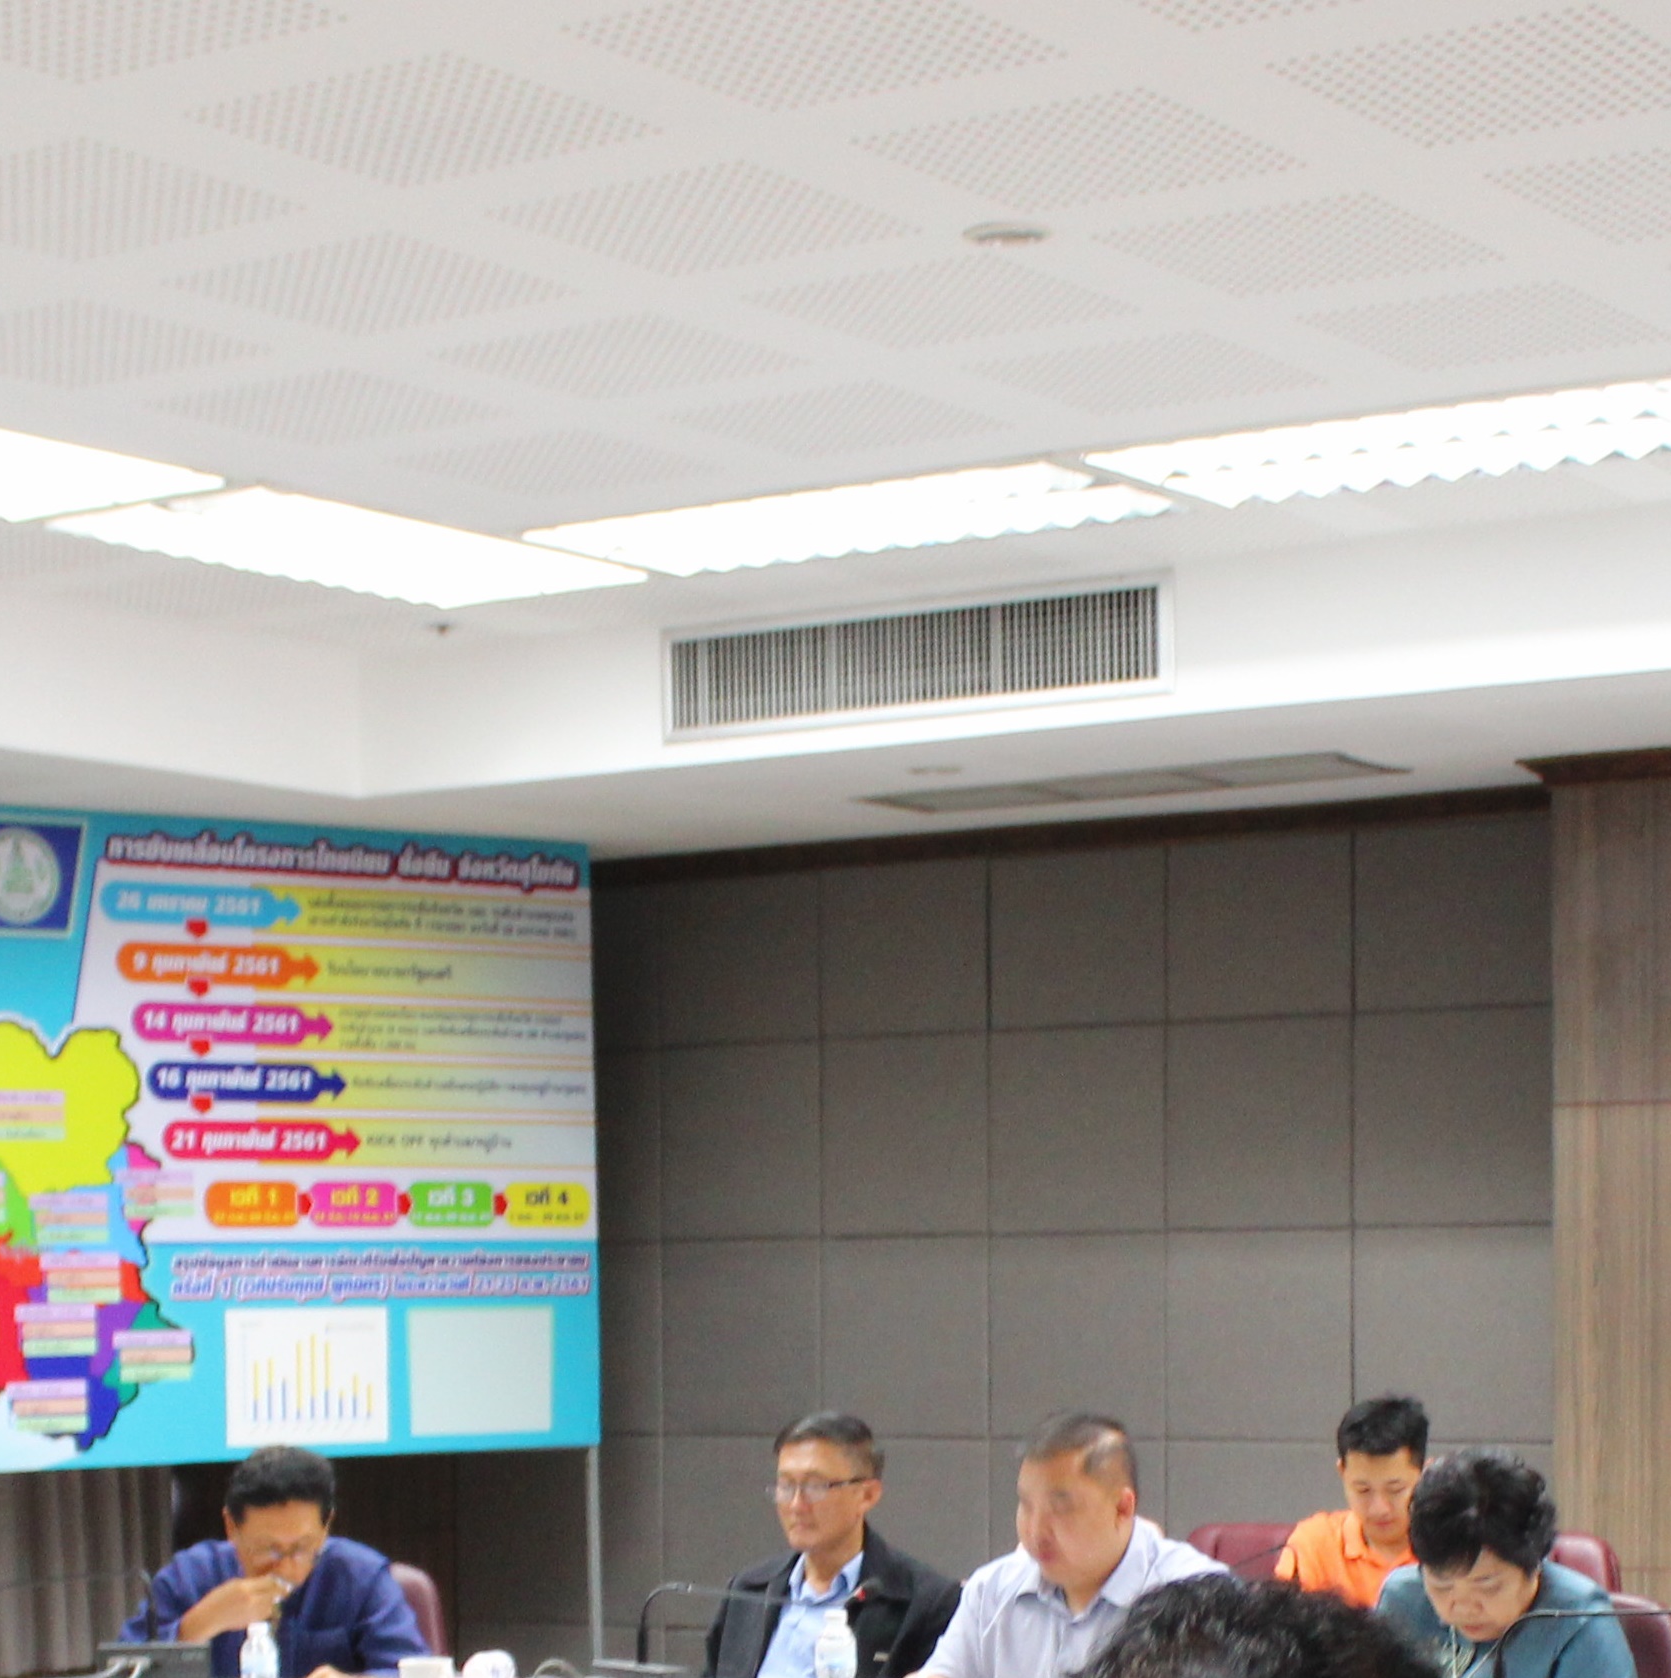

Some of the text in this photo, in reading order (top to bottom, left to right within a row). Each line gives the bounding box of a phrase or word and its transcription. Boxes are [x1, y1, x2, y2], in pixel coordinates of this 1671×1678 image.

[232, 953, 281, 976] 2561
[143, 1012, 166, 1031] 14
[252, 1014, 301, 1034] 2561
[156, 1069, 179, 1089] 16
[265, 1070, 313, 1091] 2561
[171, 1130, 195, 1151] 21
[280, 1130, 329, 1152] 2561
[267, 1187, 278, 1206] 1
[365, 1187, 380, 1208] 2
[461, 1187, 476, 1207] 3
[557, 1189, 569, 1206] 4
